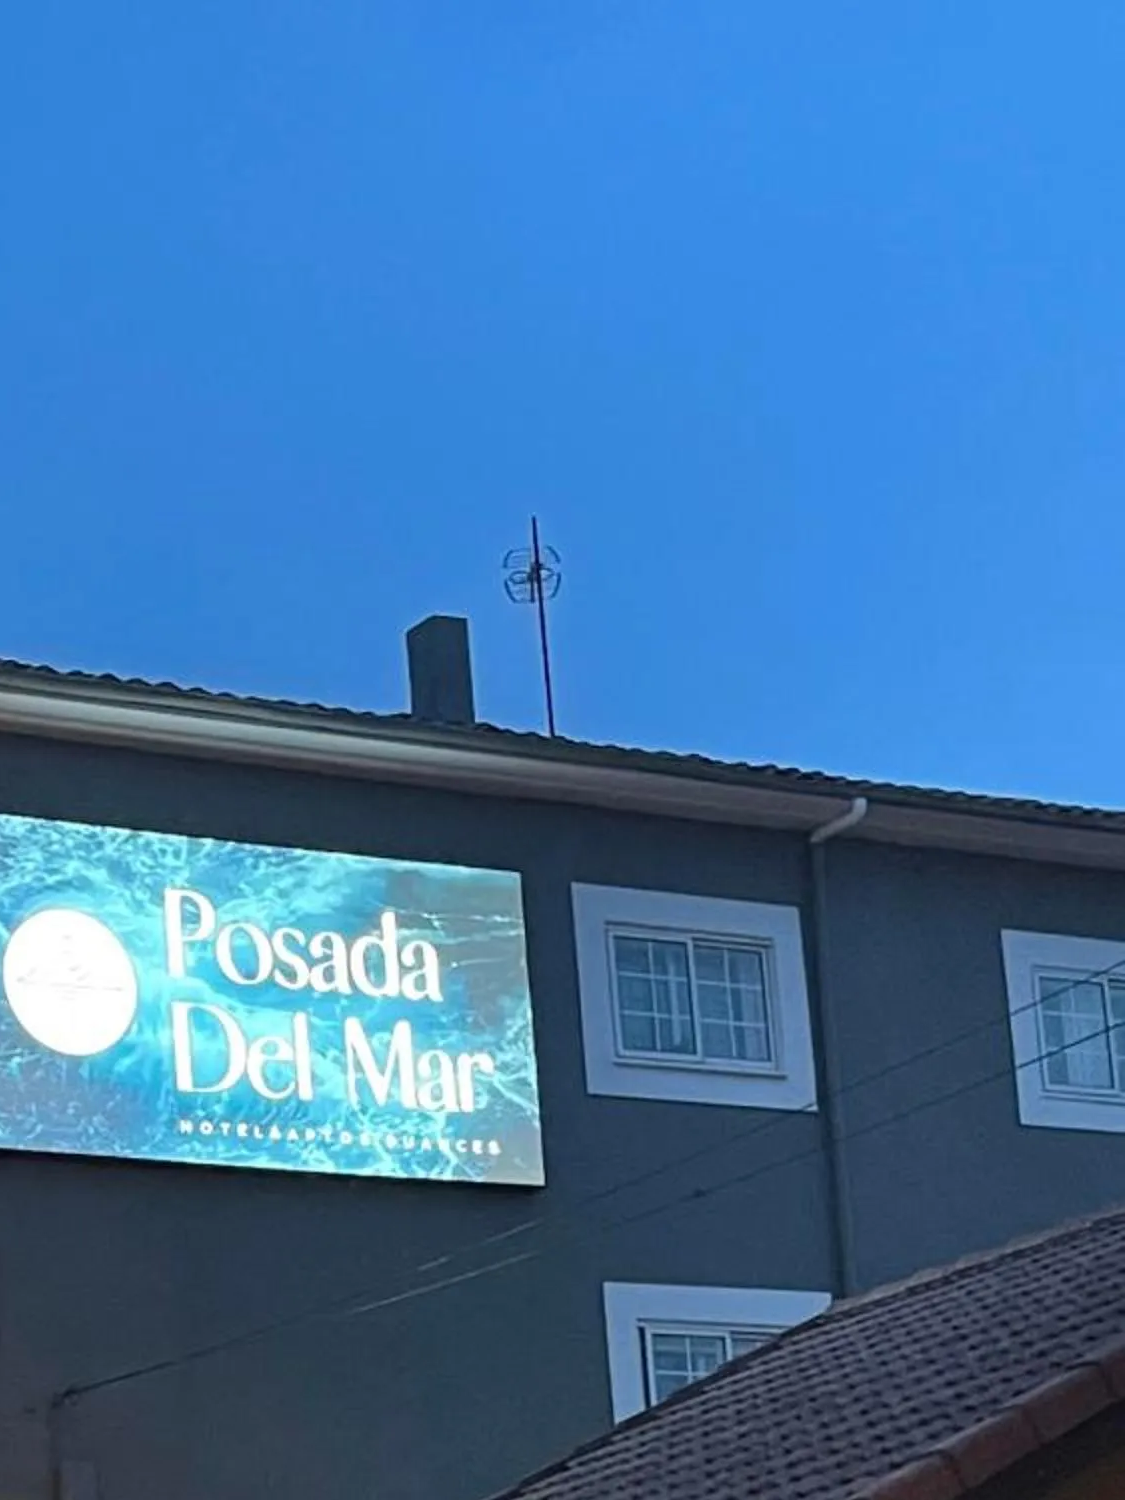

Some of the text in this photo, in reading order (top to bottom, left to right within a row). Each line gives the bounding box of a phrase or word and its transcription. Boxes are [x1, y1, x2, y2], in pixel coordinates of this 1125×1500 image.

[163, 886, 444, 1003] Posada
[170, 1000, 496, 1113] Del Mar
